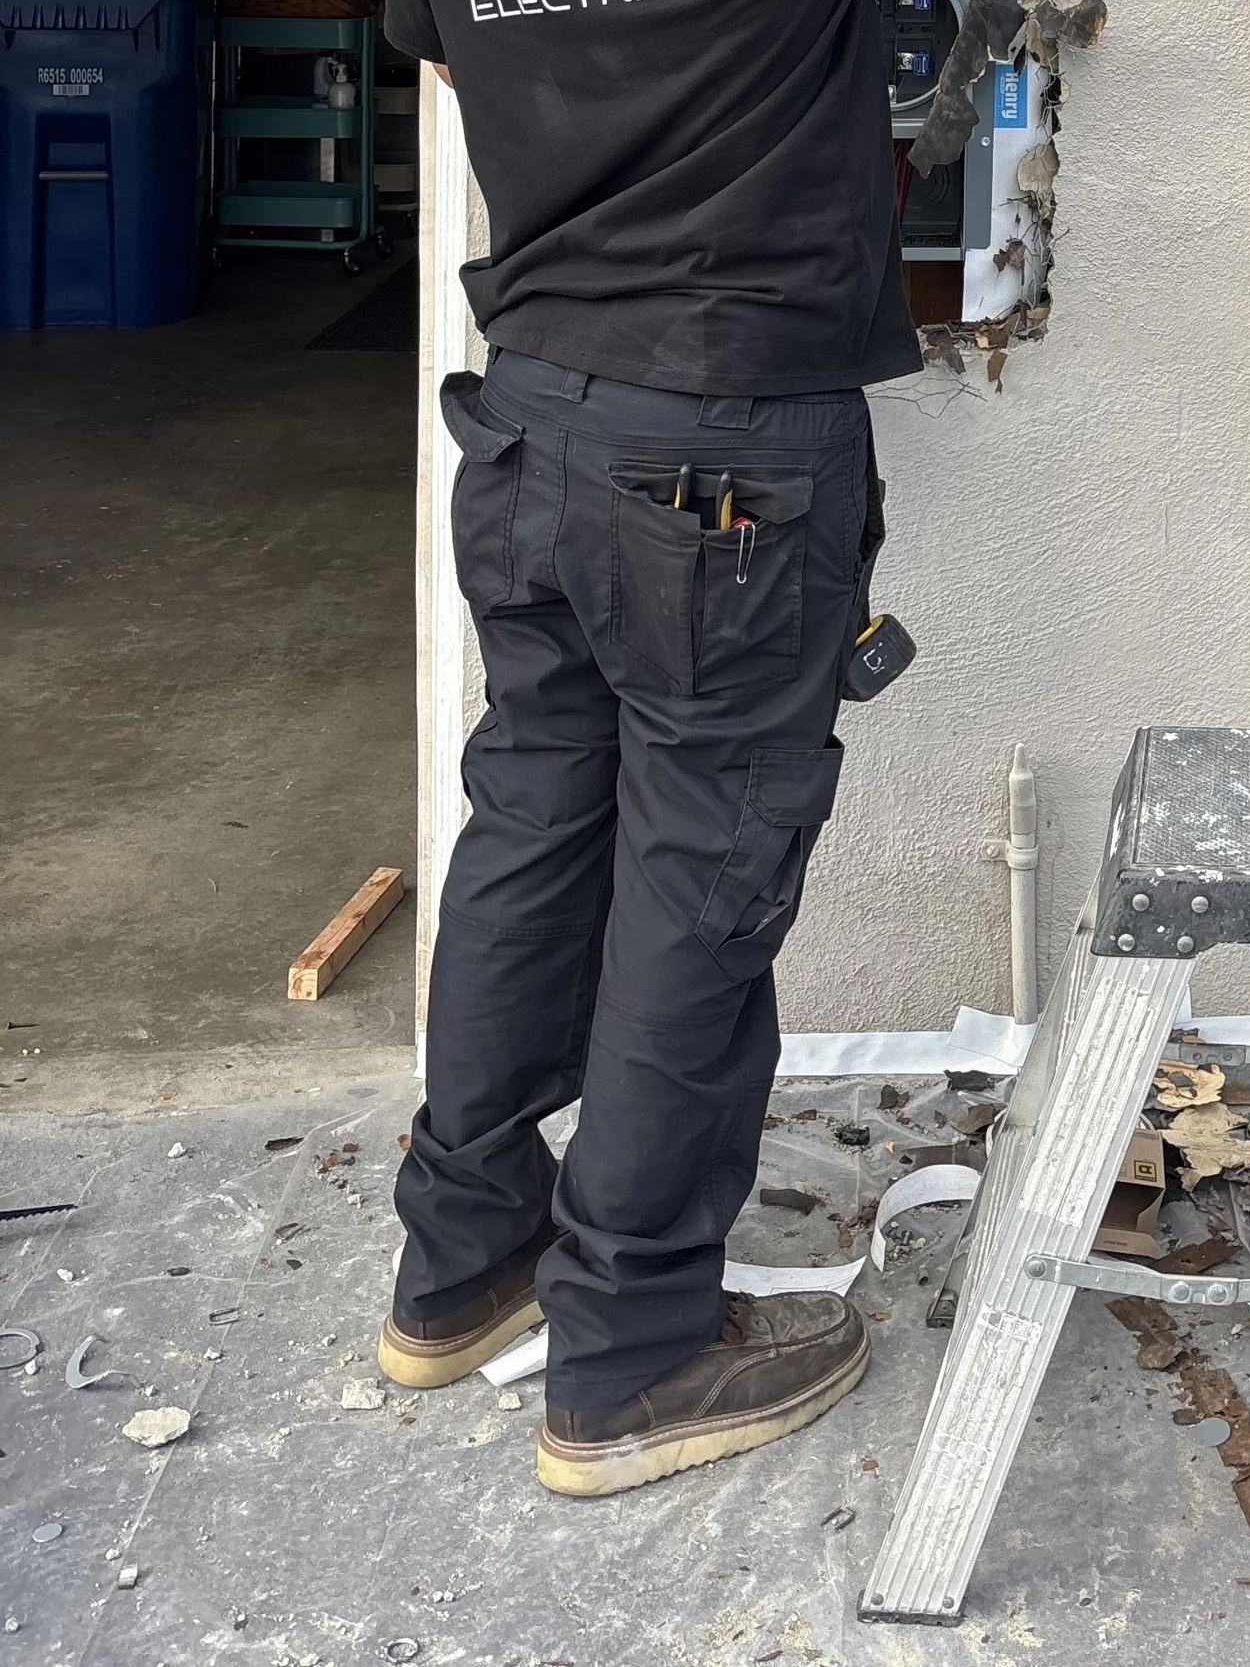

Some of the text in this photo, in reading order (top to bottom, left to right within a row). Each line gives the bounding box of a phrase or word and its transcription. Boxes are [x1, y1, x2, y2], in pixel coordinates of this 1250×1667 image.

[38, 68, 103, 84] R6515 000654
[1002, 71, 1018, 120] Henry
